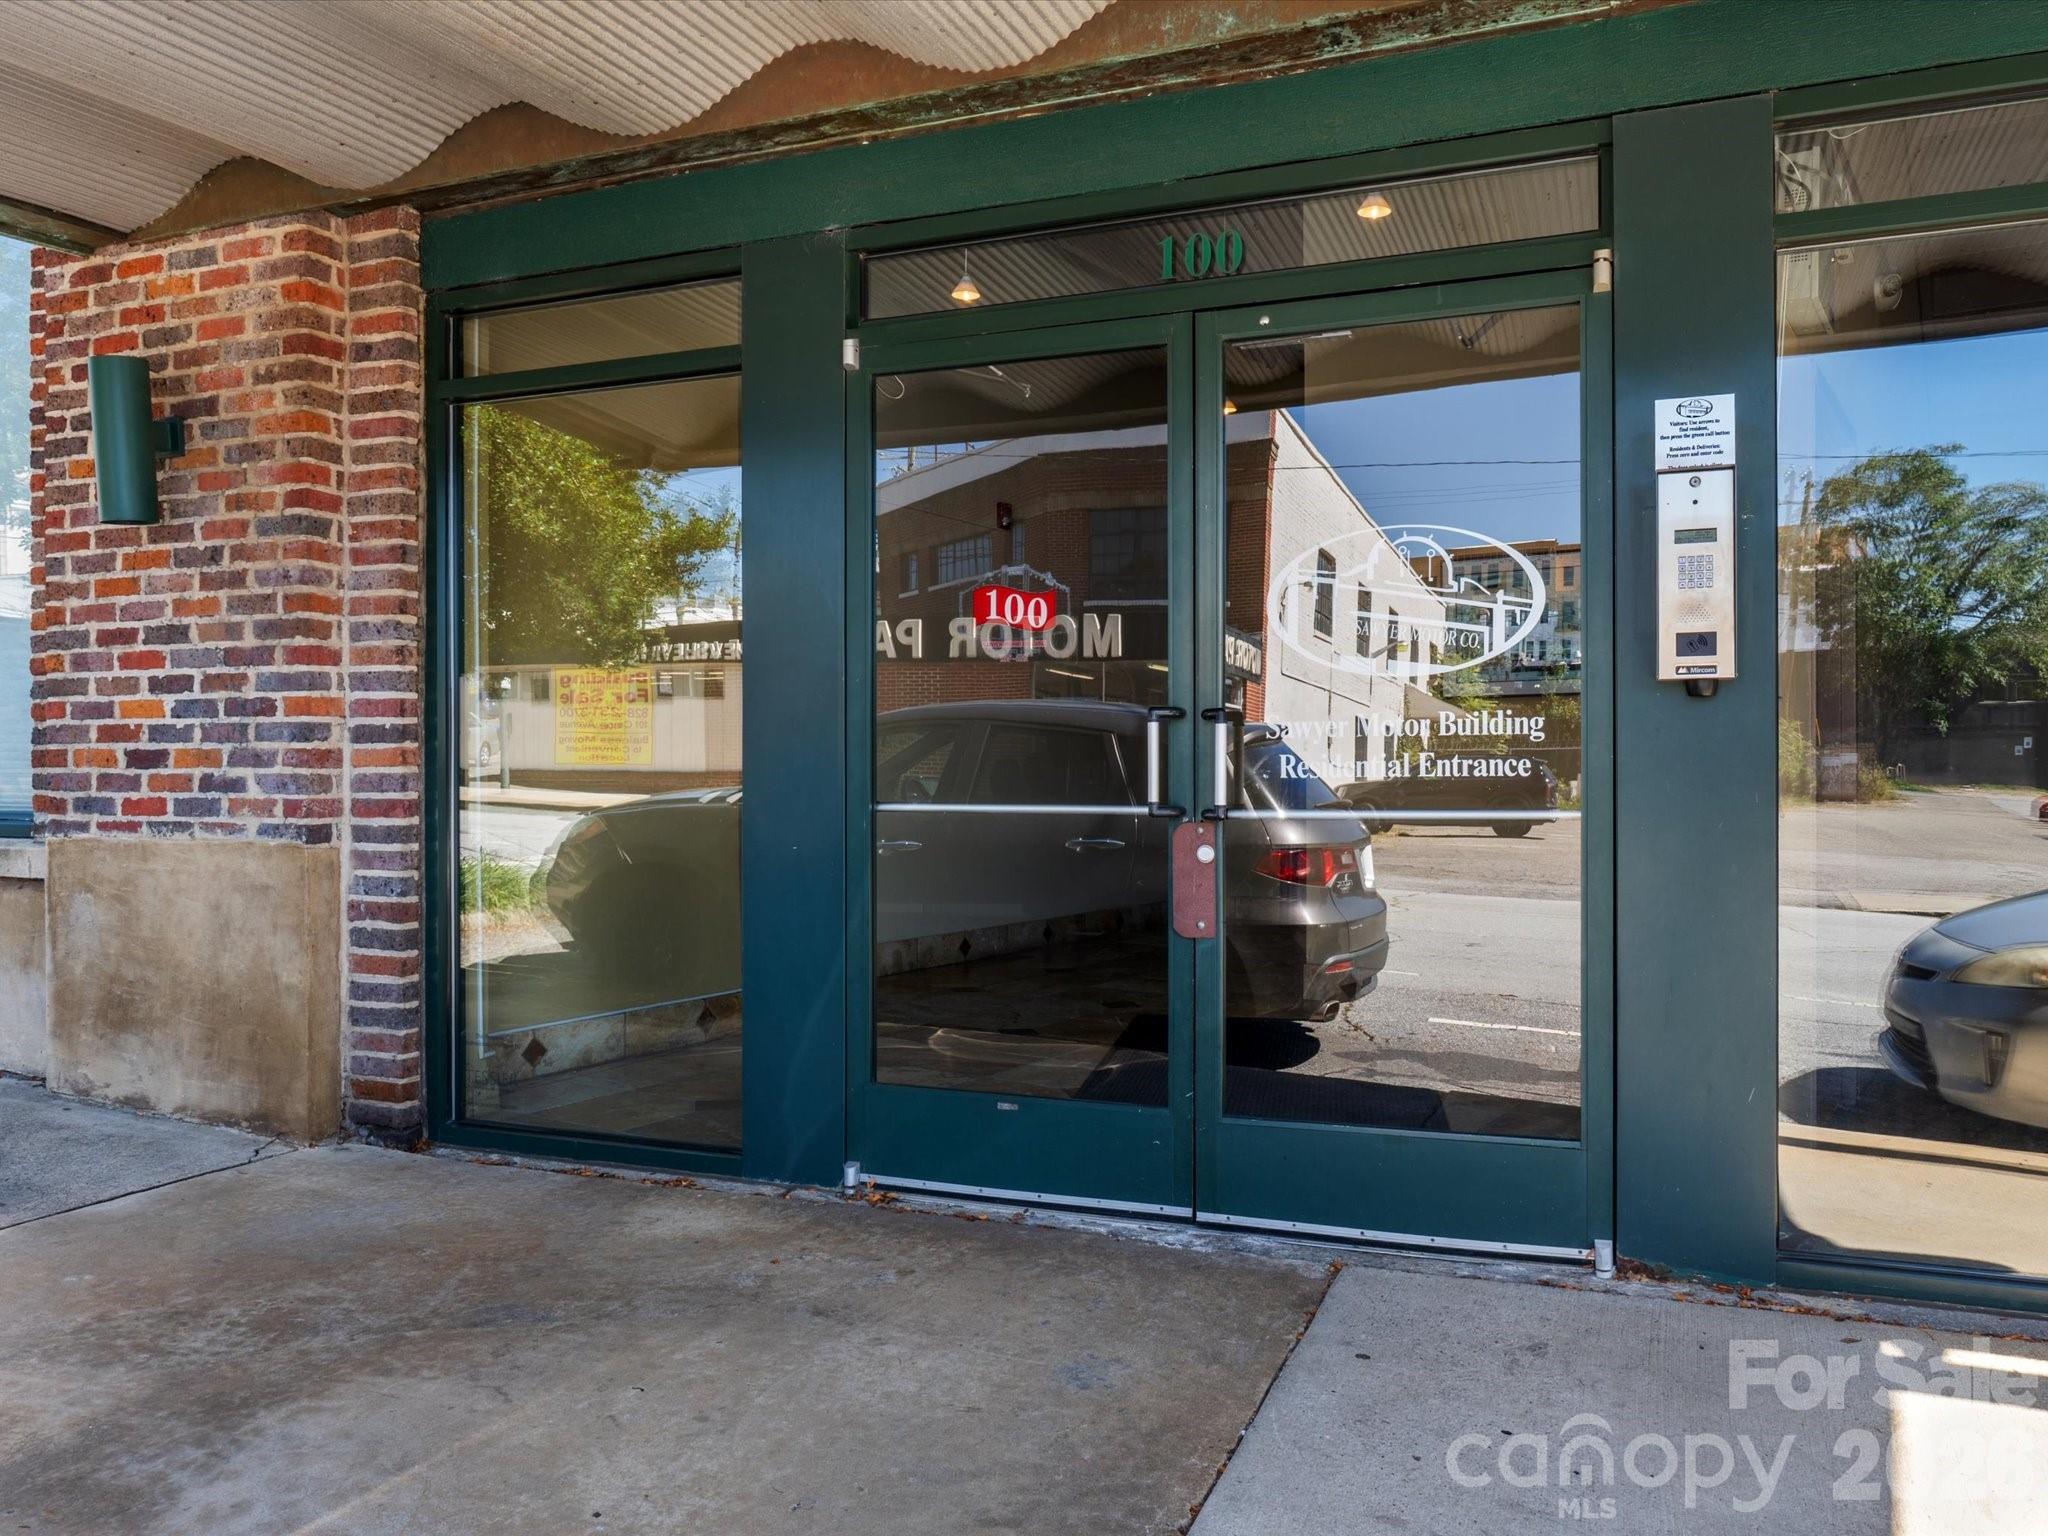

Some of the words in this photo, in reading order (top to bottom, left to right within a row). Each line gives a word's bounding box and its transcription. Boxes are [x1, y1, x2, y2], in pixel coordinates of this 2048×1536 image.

[1157, 228, 1243, 280] 100
[985, 588, 1048, 630] 100
[1460, 630, 1481, 649] CO.
[1266, 714, 1348, 743] Sawyer
[1357, 713, 1430, 737] Motor
[1438, 709, 1545, 742] Building
[1279, 752, 1410, 779] Residential
[1418, 752, 1532, 777] Entrance
